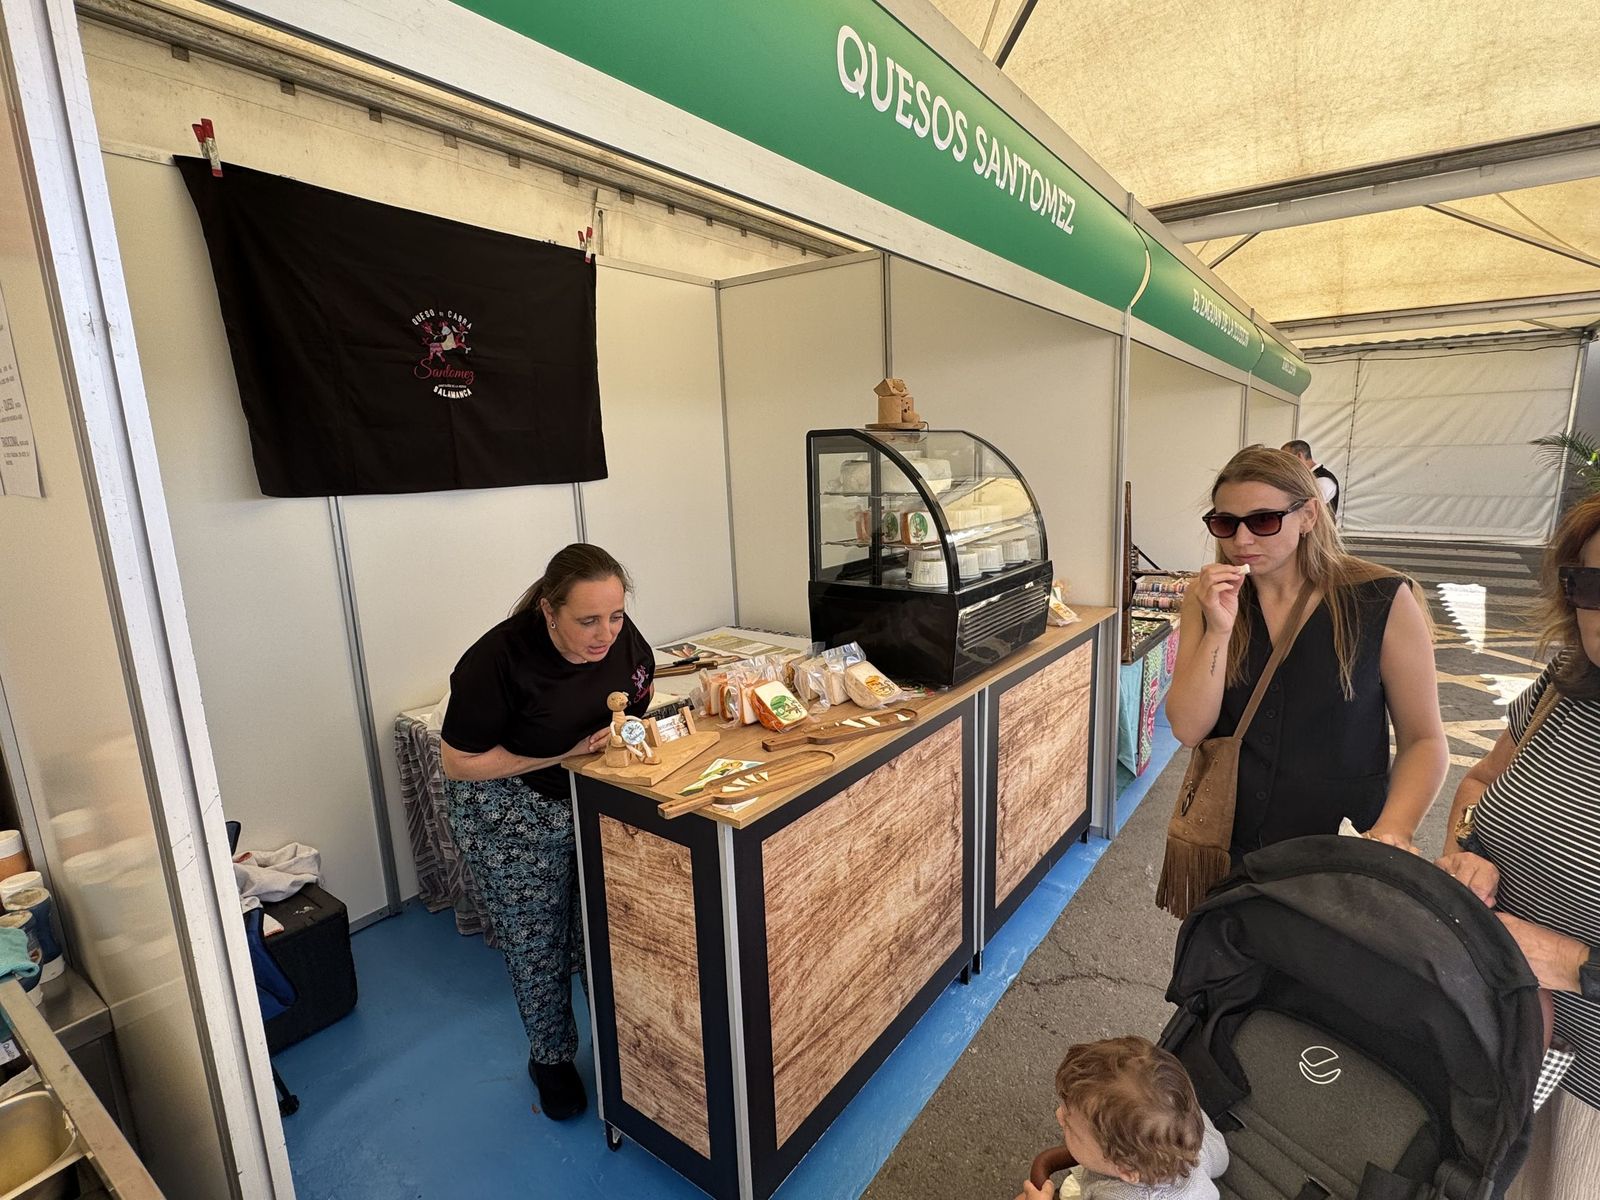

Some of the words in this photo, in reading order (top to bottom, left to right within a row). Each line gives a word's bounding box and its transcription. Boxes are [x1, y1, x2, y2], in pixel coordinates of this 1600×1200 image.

[837, 25, 968, 162] QUESOS
[973, 125, 1076, 235] SANTOMEZ
[411, 308, 435, 326] QUESO
[447, 310, 472, 330] CABRA
[414, 358, 474, 385] Santomez
[433, 385, 472, 399] SALAMANCA
